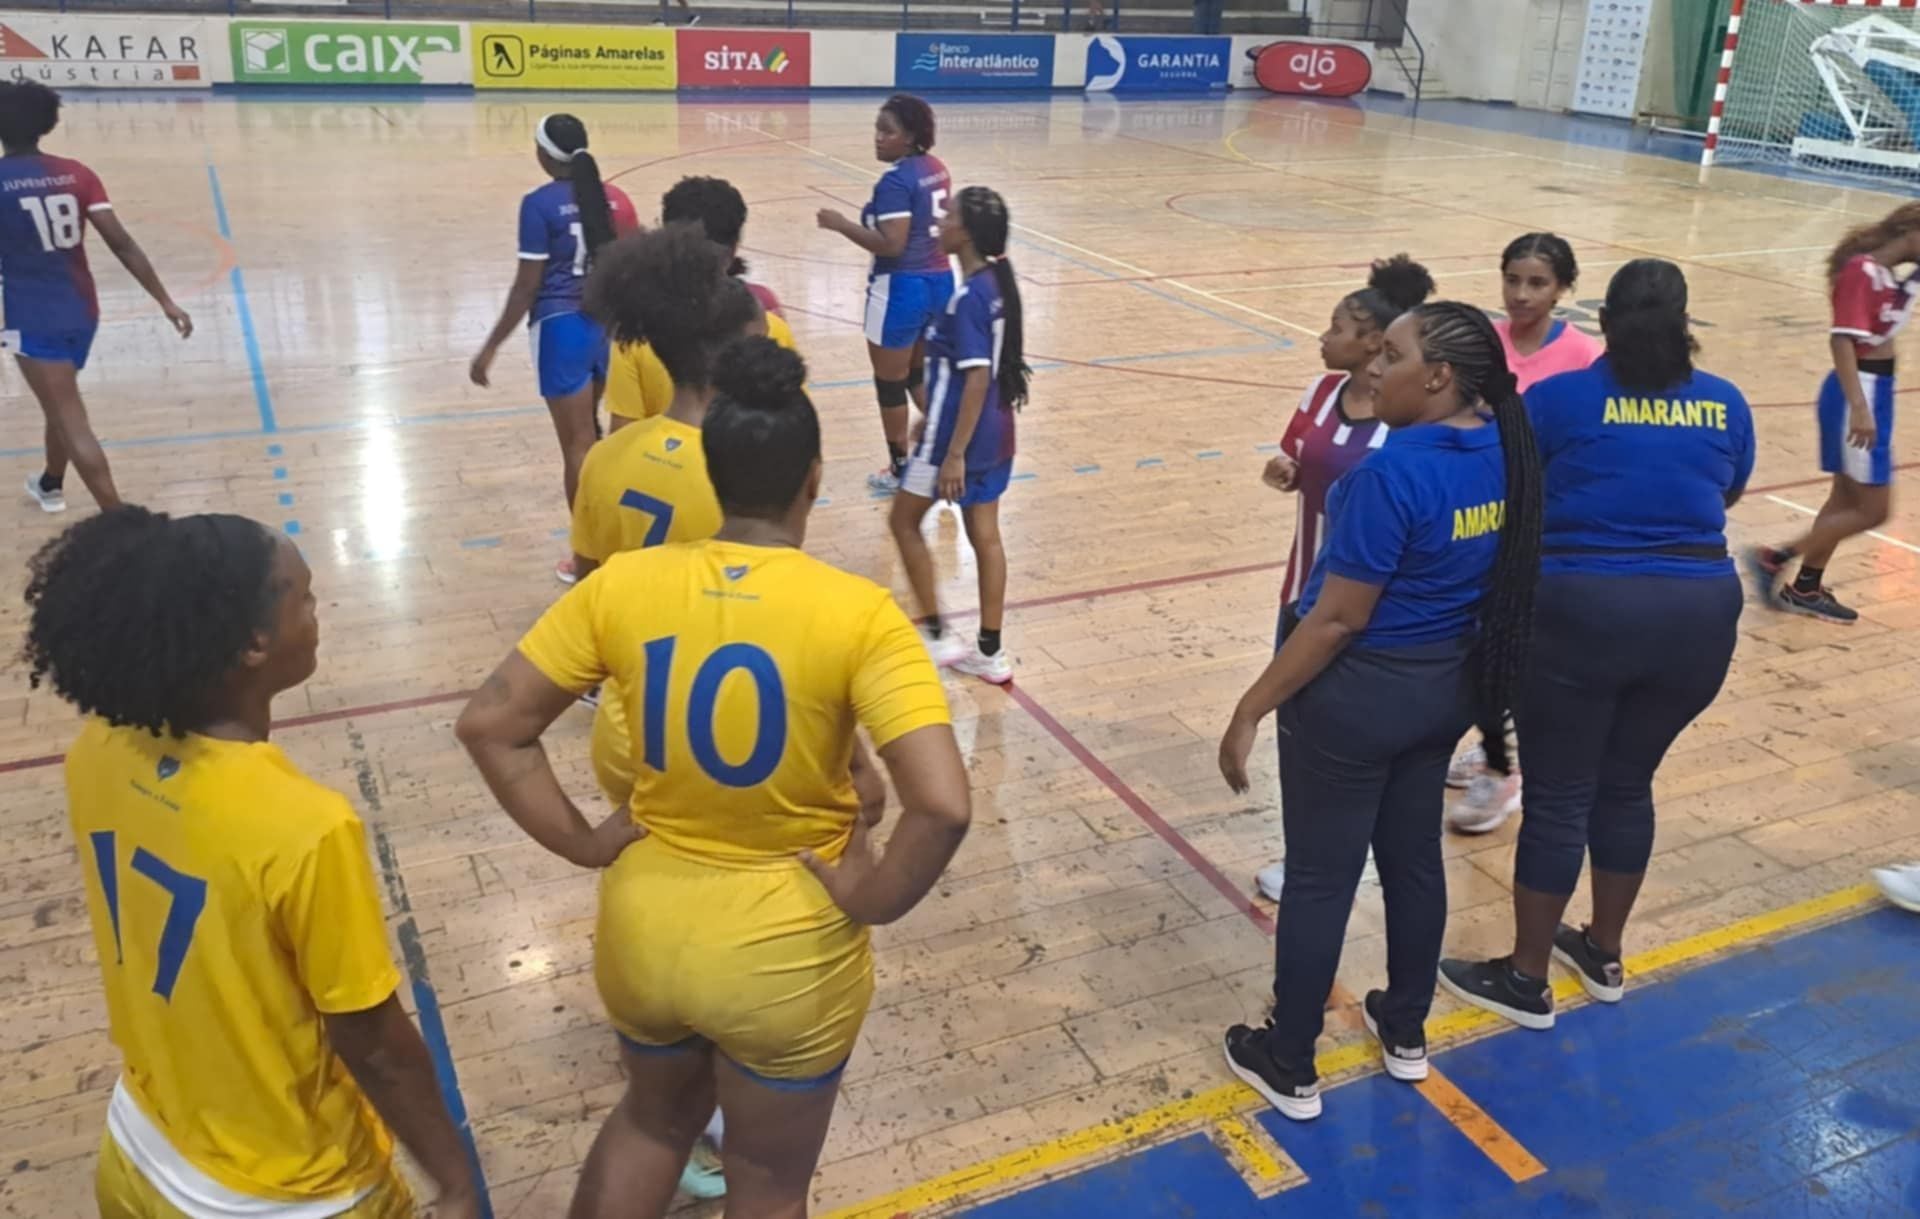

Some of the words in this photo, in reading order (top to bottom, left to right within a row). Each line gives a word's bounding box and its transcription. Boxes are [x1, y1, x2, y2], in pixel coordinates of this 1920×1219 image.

[51, 34, 199, 60] KAFAR
[529, 44, 591, 62] Páginas
[595, 45, 666, 61] Amarelas
[1137, 53, 1220, 69] GARANTIA
[18, 193, 82, 252] 18
[1602, 396, 1728, 431] AMARANTE
[618, 487, 675, 548] 7
[642, 634, 788, 789] 10
[89, 829, 209, 1006] 17
